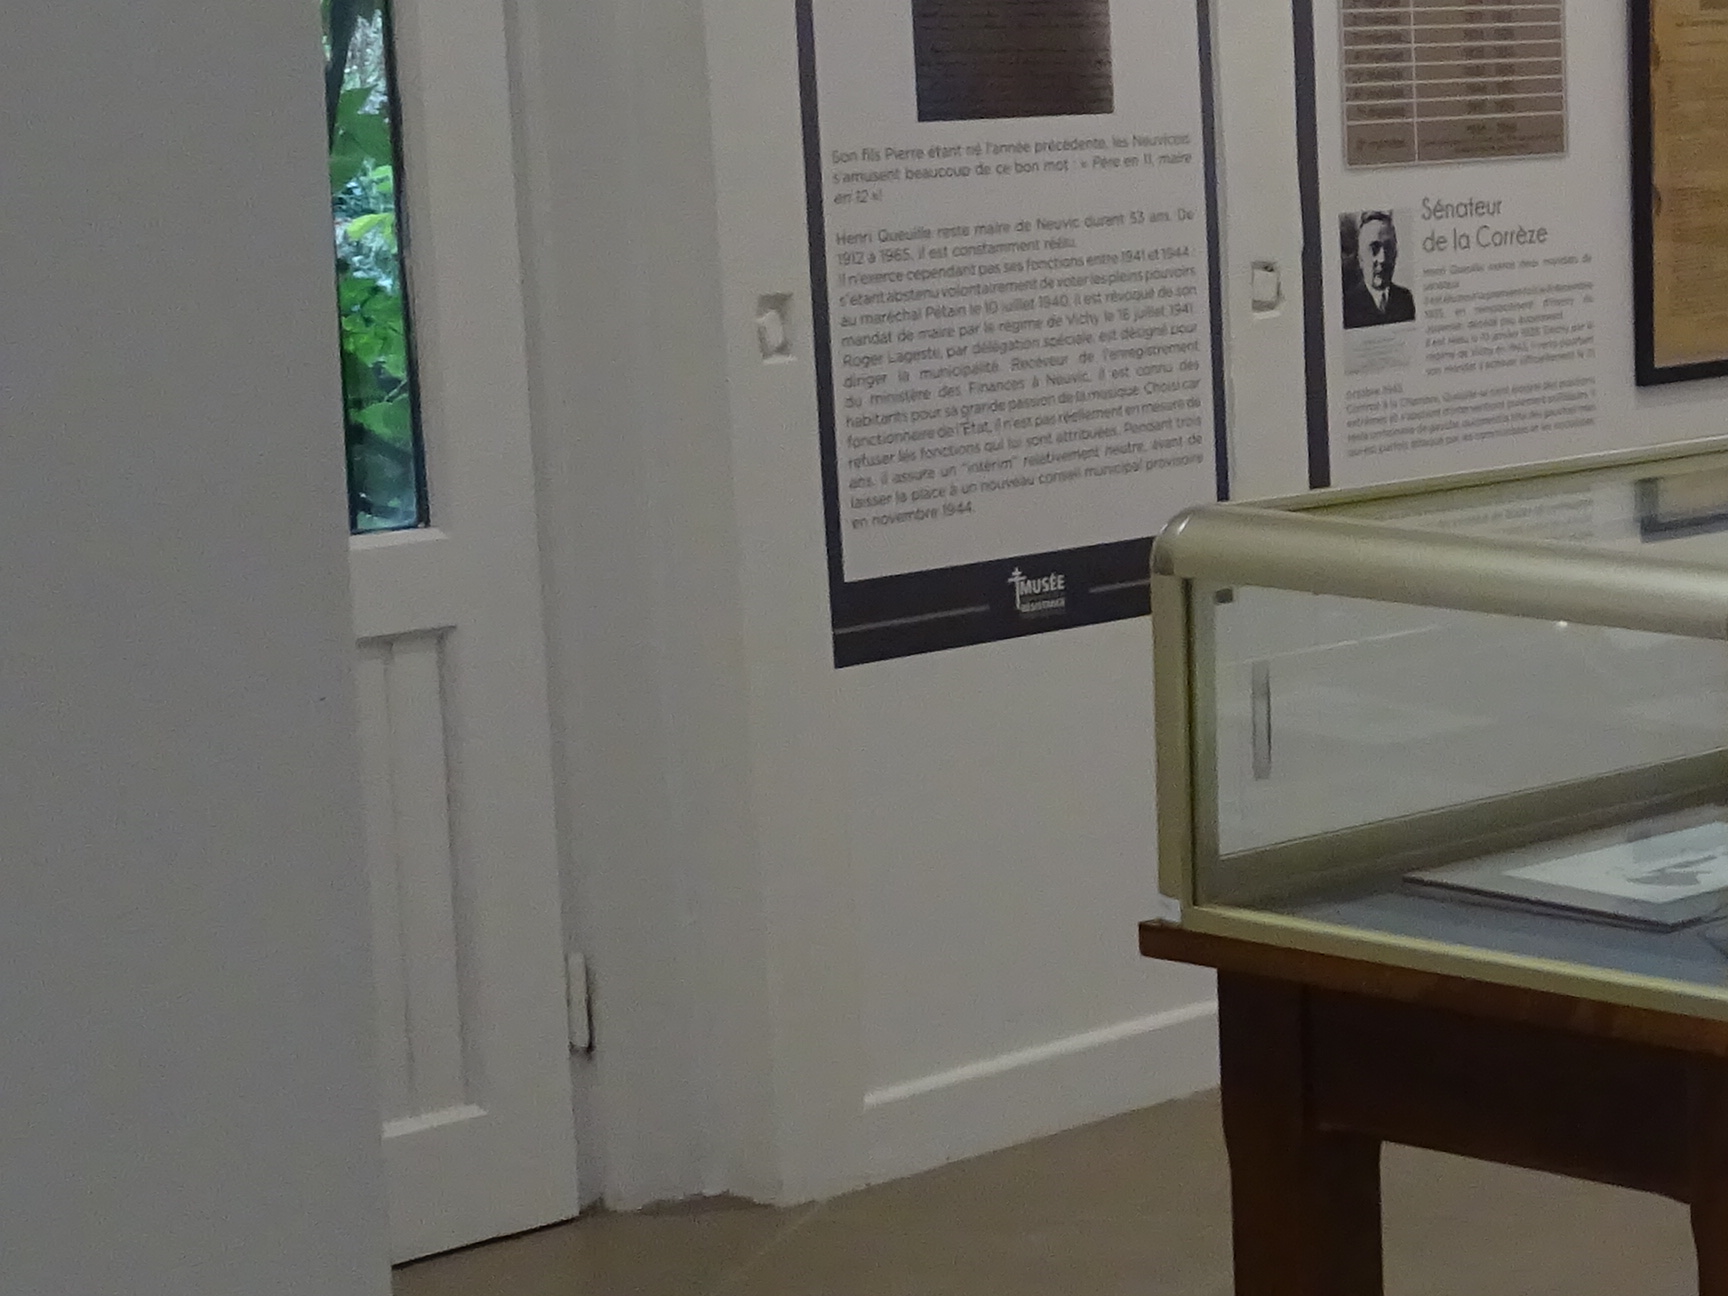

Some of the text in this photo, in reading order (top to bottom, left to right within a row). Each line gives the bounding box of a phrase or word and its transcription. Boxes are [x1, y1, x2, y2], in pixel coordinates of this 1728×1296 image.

[1421, 196, 1502, 221] Sénateur
[1422, 224, 1548, 252] de la Corrèze
[1020, 572, 1065, 595] MUSÉE
